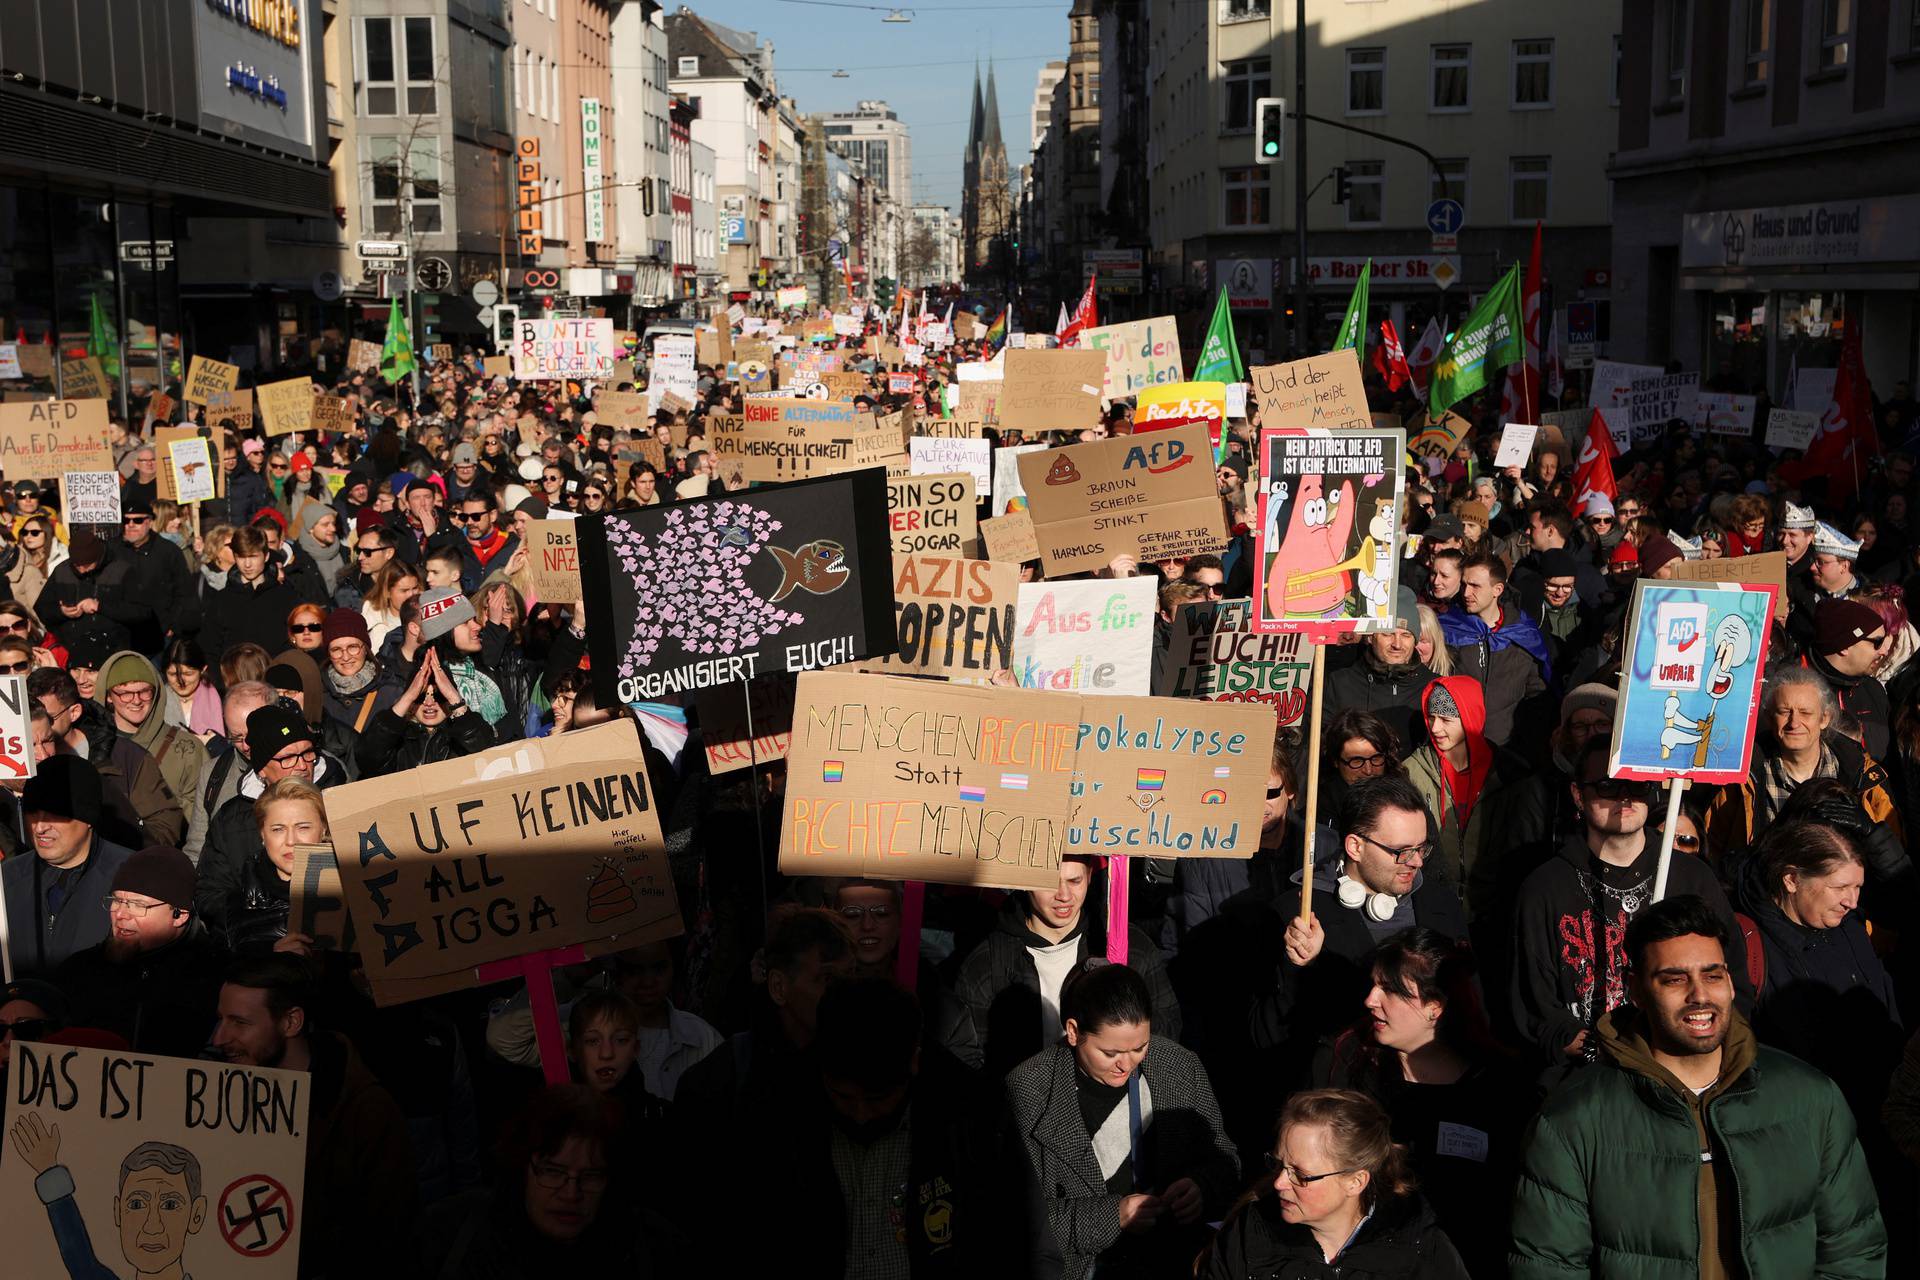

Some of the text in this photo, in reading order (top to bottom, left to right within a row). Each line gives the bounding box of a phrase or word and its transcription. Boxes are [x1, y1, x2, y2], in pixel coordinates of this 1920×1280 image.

[584, 102, 601, 238] HOME COMPANY
[521, 139, 537, 250] OPTIK
[720, 211, 728, 252] HOTEL
[1753, 205, 1860, 238] Haus und Grund
[521, 322, 597, 342] BUNTE
[1140, 326, 1175, 358] den
[1570, 332, 1593, 341] TAXI
[521, 340, 601, 357] REPUBLIK
[199, 358, 230, 377] ALLE
[521, 356, 614, 374] DEUTSCHLAND
[194, 373, 229, 391] HASSEN
[1258, 363, 1330, 394] Und der
[1632, 373, 1698, 392] REMIGRIERT
[1265, 384, 1347, 415] Mensch heißt
[1632, 387, 1680, 404] EUCH INS
[29, 402, 78, 421] AFD
[745, 403, 854, 423] KEINE ALTERNATIVE
[1632, 402, 1677, 423] KNIE!
[788, 425, 806, 438] FÜR
[744, 439, 854, 460] MENSCHLICHKEIT
[933, 438, 966, 450] EURE
[1285, 439, 1382, 456] NEIN PATRICK DIE AFD
[914, 449, 990, 466] ALTERNATIVE
[1122, 440, 1185, 470] AfD
[1283, 456, 1384, 474] IST KEINE ALTERNATIVE
[67, 473, 115, 484] MENSCHEN
[1086, 476, 1136, 496] BRAUN
[67, 484, 103, 496] RECHTE
[887, 482, 964, 509] BIN SO
[81, 499, 107, 509] RECHTE
[70, 511, 118, 522] MENSCHEN
[889, 509, 958, 531] ER ICH
[1094, 513, 1150, 530] STINKT
[546, 532, 571, 546] Das
[900, 533, 961, 553] SOGAR
[1137, 527, 1210, 544] GEFAHR FÜR
[1052, 543, 1105, 561] HARMLOS
[1140, 544, 1158, 553] DIE
[543, 548, 578, 571] NAZ
[1677, 558, 1762, 580] LIBERTÉ
[895, 556, 993, 604] AZIS
[1023, 591, 1143, 638] Aus für
[883, 601, 1015, 670] OPPEN
[1283, 622, 1298, 630] Post
[1670, 620, 1695, 641] AfD
[1189, 632, 1302, 666] EUCH!!!
[618, 652, 760, 705] ORGANISIERT
[785, 635, 856, 673] EUCH!
[1172, 661, 1311, 697] LEISTET
[894, 760, 963, 786] Statt
[1070, 771, 1104, 797] ür
[512, 772, 649, 840] KEINEN
[612, 829, 630, 838] Hier
[624, 846, 634, 854] es
[626, 852, 649, 863] nach
[18, 1045, 300, 1137] DAS IST BJÖRN.
